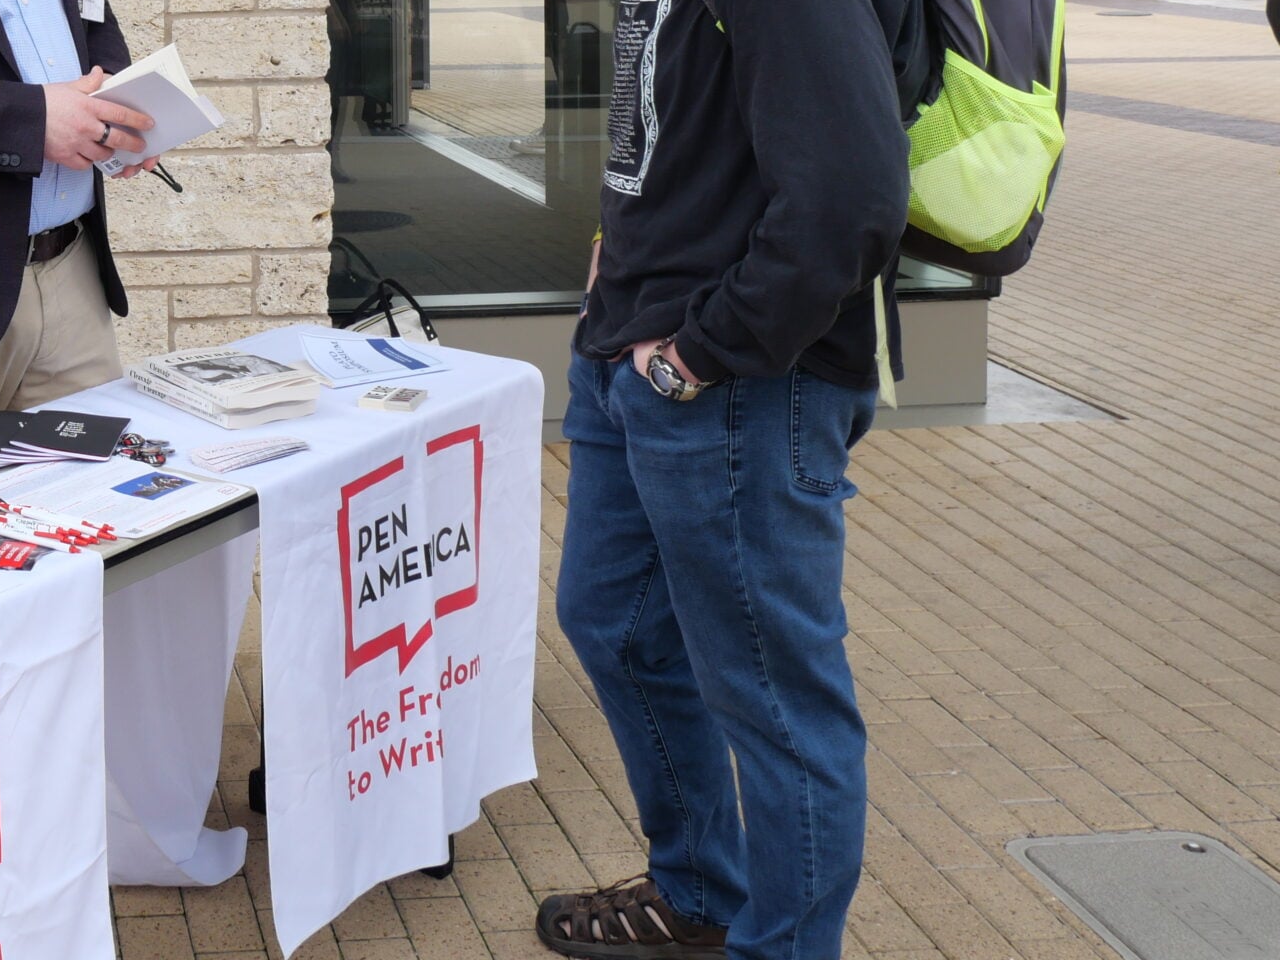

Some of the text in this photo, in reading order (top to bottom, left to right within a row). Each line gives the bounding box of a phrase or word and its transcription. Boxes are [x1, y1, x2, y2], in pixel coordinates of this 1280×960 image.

[357, 503, 408, 562] PEN
[346, 654, 481, 753] The Frdom
[348, 728, 445, 802] to Writ
